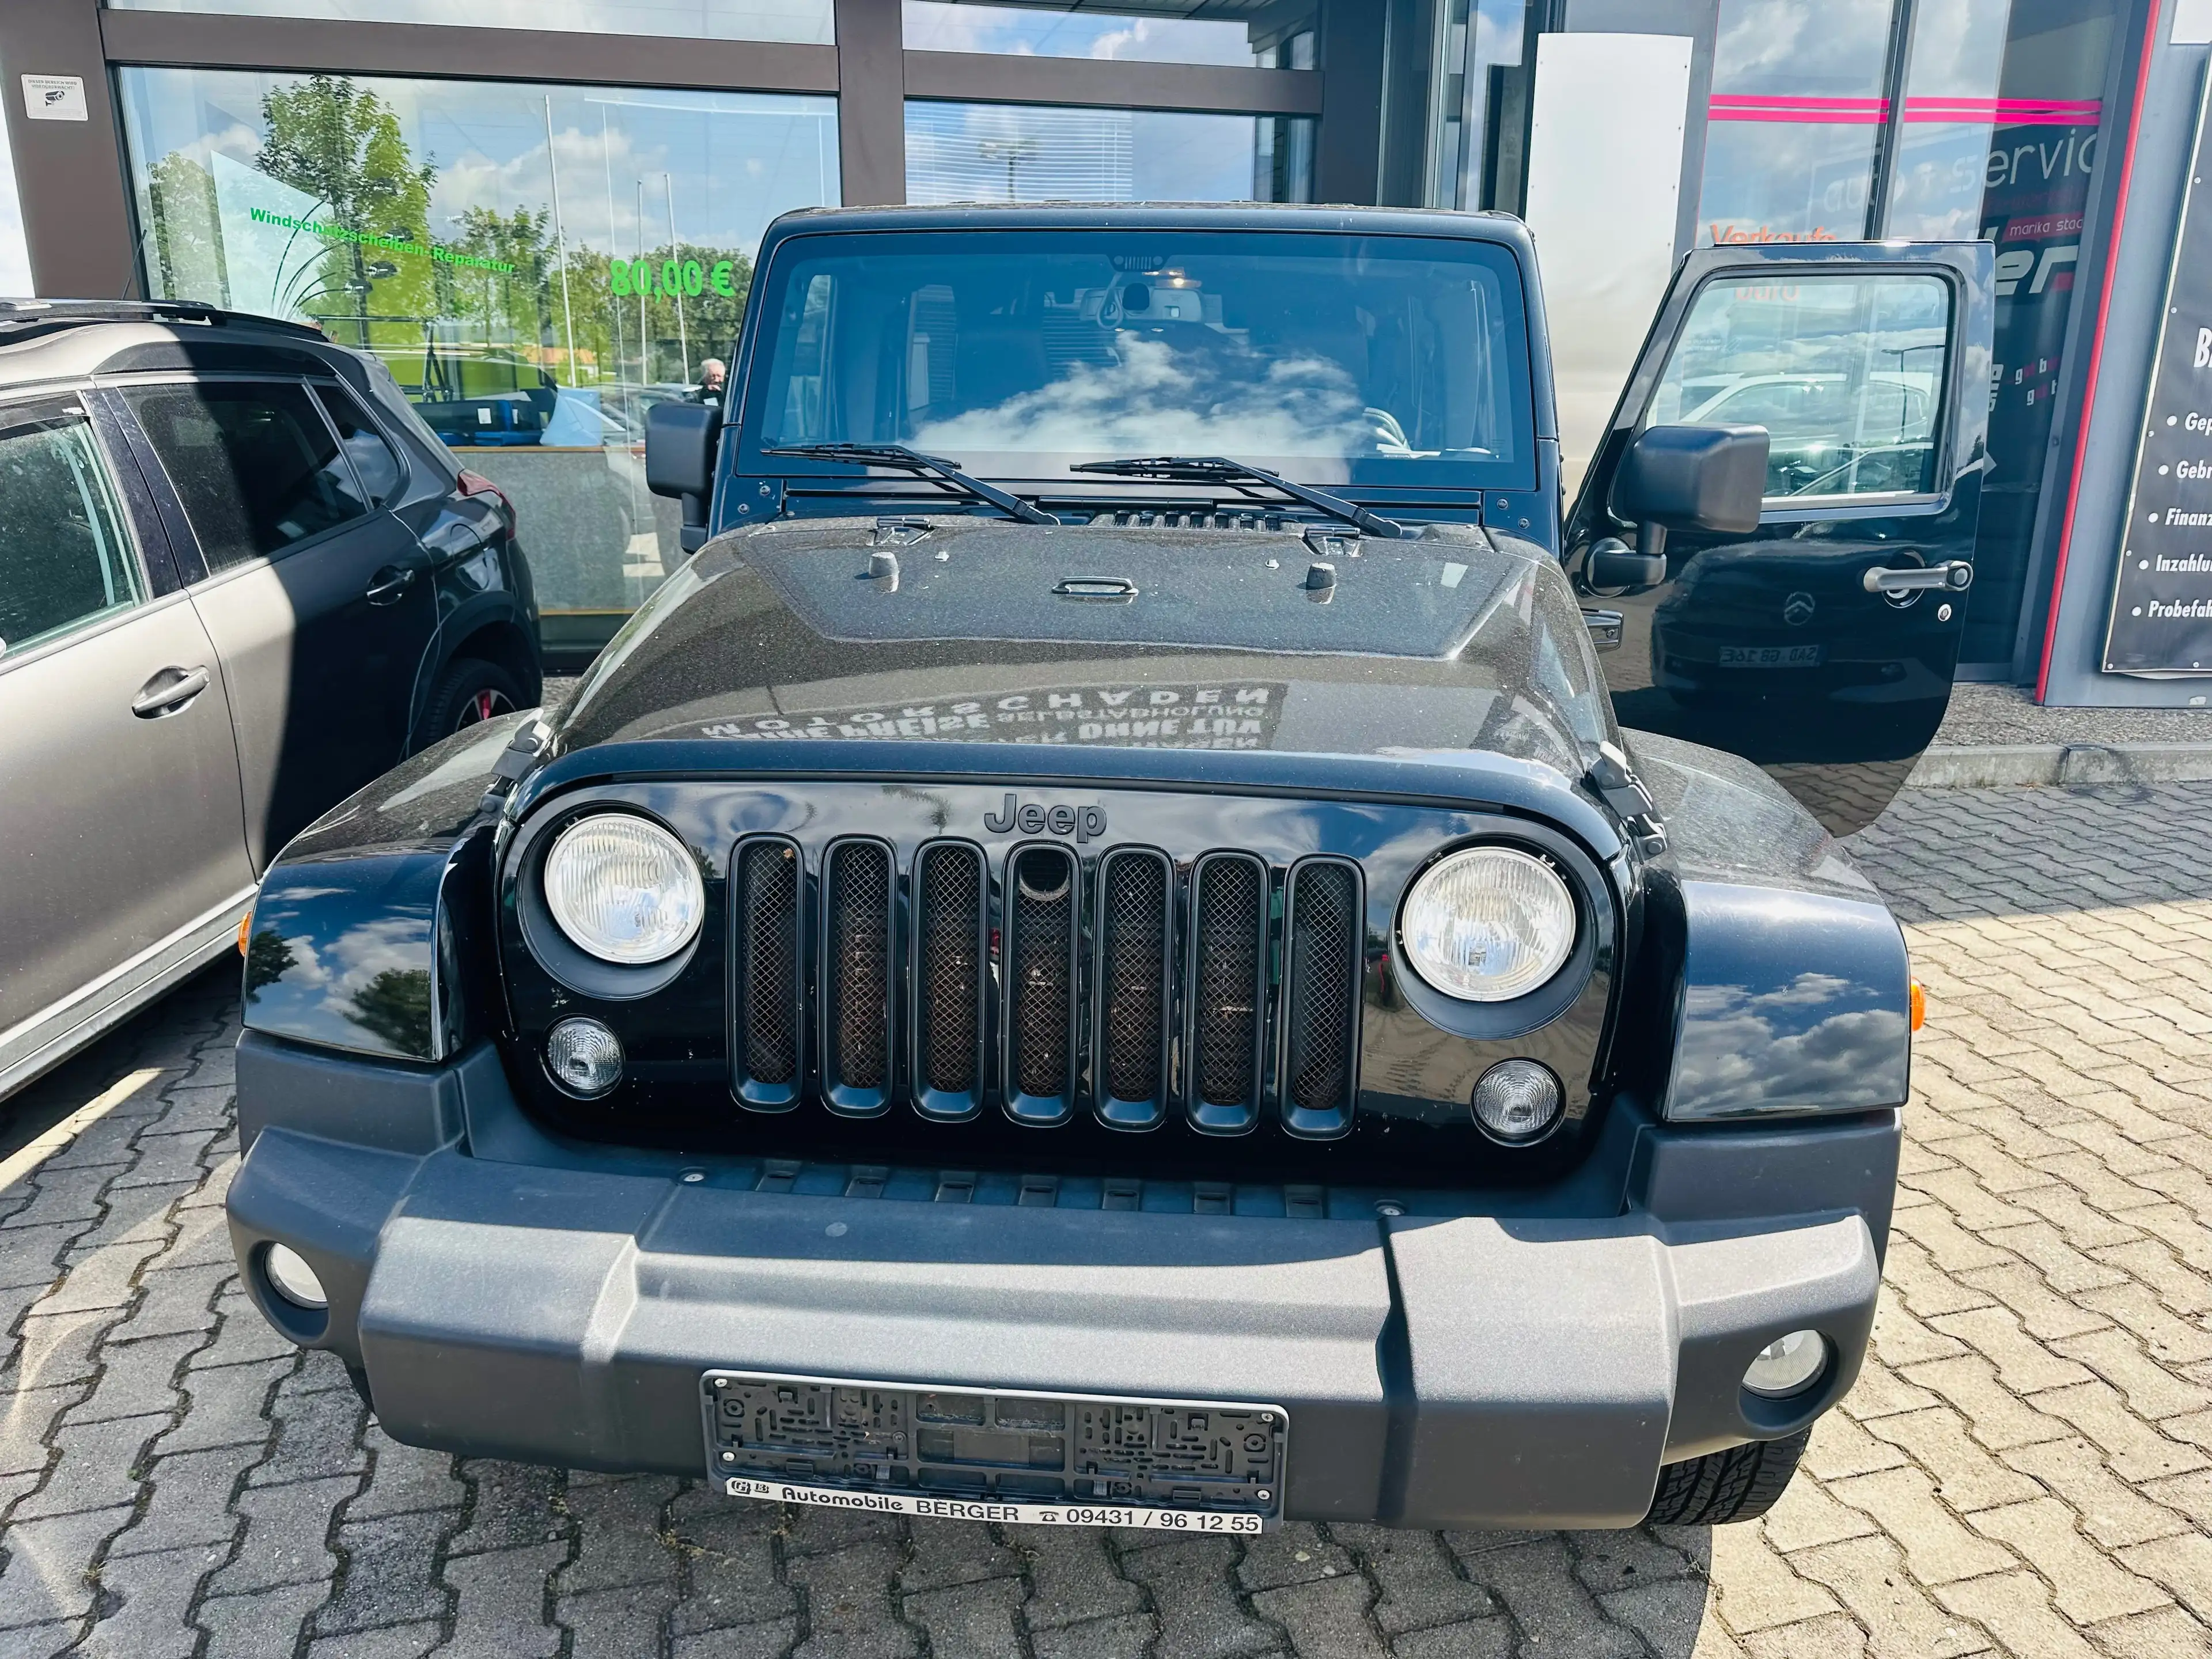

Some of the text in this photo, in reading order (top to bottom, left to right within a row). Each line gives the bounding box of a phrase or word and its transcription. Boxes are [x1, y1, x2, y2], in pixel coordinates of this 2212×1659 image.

[2010, 222, 2050, 237] marika
[432, 246, 516, 274] Reparatur
[610, 259, 736, 304] 80,00 €
[2165, 507, 2212, 526] Finanz
[2147, 599, 2212, 618] Probefah
[983, 793, 1107, 844] Jeep
[782, 1486, 903, 1510] Automobile
[916, 1500, 1020, 1522] BERGER
[1066, 1509, 1133, 1525] 09431
[1143, 1511, 1153, 1526] /
[1160, 1513, 1187, 1528] 96
[1198, 1514, 1223, 1530] 12
[1231, 1516, 1259, 1531] 55
